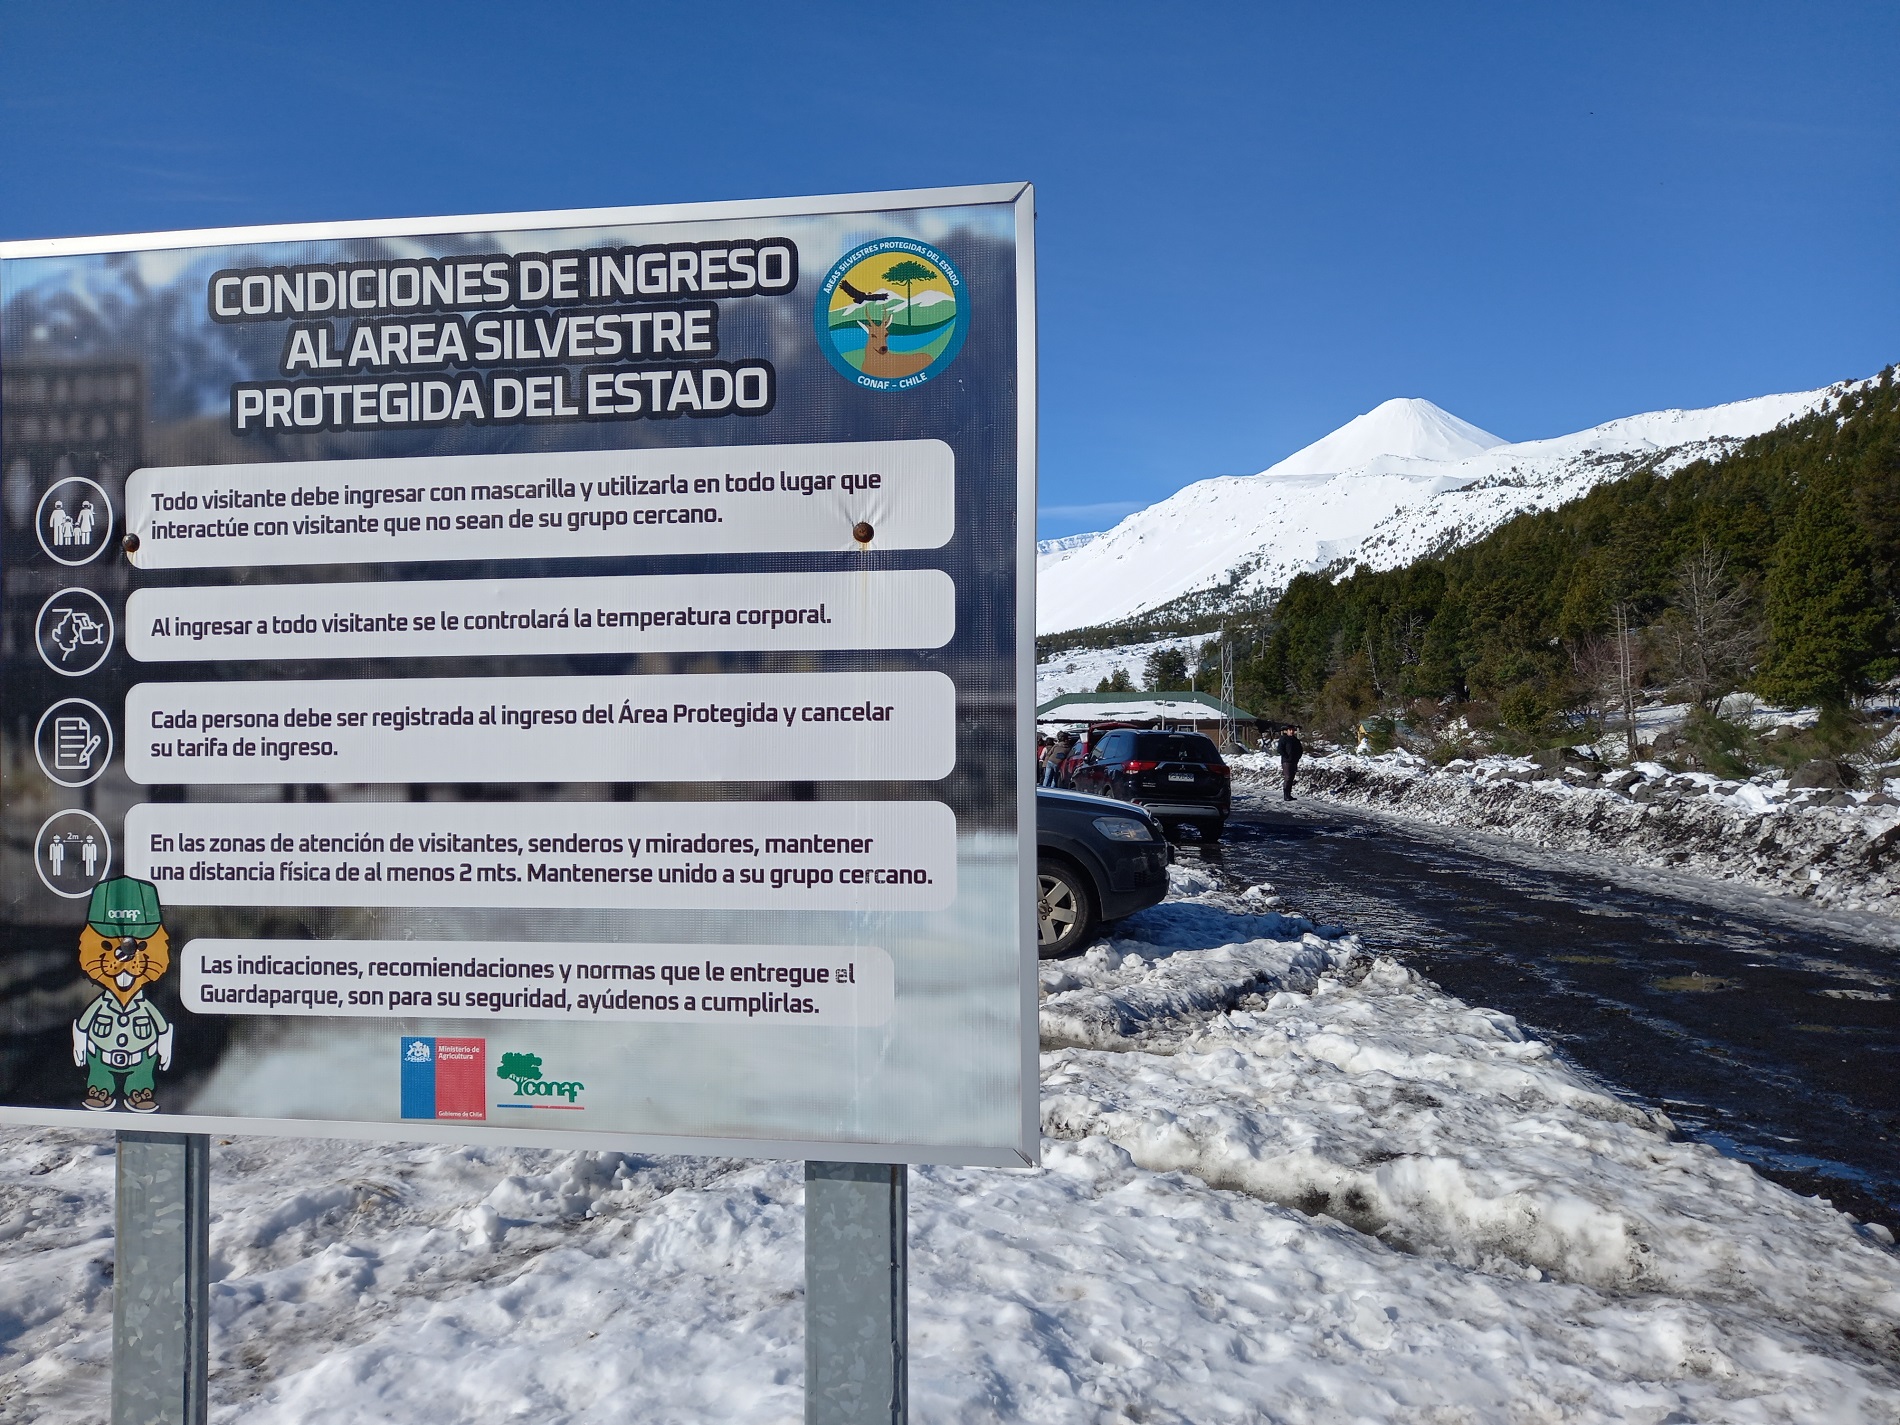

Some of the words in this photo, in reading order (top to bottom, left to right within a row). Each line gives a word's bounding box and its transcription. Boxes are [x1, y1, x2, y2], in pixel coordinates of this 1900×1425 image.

[214, 263, 510, 317] CONDICIONES
[519, 260, 578, 302] DE
[588, 246, 791, 299] INGRESO
[839, 244, 878, 272] SILVESTRES
[880, 242, 926, 254] PROTEGIDAS
[926, 251, 940, 265] DEL
[939, 260, 960, 286] ESTADO
[286, 329, 342, 371] AL
[348, 321, 468, 366] AREA
[475, 310, 712, 361] SILVESTRE
[238, 376, 484, 429] PROTEGIDA
[494, 375, 578, 418] DEL
[587, 367, 767, 415] ESTADO
[857, 376, 889, 389] CONAF
[899, 373, 927, 387] CHILE
[150, 490, 198, 512] Todo
[201, 488, 287, 510] visitante
[290, 486, 340, 507] debe
[344, 484, 426, 509] ingresar
[429, 486, 466, 502] con
[471, 477, 576, 501] mascarilla
[579, 482, 594, 502] y
[597, 473, 689, 497] utilizarla
[693, 478, 720, 494] en
[725, 471, 775, 493] todo
[780, 470, 837, 496] lugar
[840, 473, 882, 495] que
[151, 516, 249, 540] interactúe
[253, 521, 289, 537] con
[292, 514, 379, 535] visitante
[383, 516, 421, 537] que
[425, 515, 451, 531] no
[455, 514, 504, 530] sean
[508, 508, 534, 529] de
[538, 512, 563, 528] su
[567, 510, 628, 532] grupo
[633, 507, 723, 525] cercano.
[150, 617, 171, 637] Al
[175, 616, 253, 641] ingresar
[256, 620, 268, 635] a
[272, 614, 317, 635] todo
[321, 612, 408, 633] visitante
[412, 616, 436, 631] se
[440, 610, 459, 631] le
[463, 607, 569, 630] controlará
[573, 607, 592, 628] la
[596, 606, 731, 632] temperatura
[736, 603, 832, 630] corporal.
[151, 709, 197, 729] Cada
[201, 713, 279, 734] persona
[283, 707, 332, 728] debe
[336, 712, 369, 727] ser
[372, 705, 474, 732] registrada
[478, 705, 497, 726] al
[501, 704, 577, 730] ingreso
[582, 703, 615, 724] del
[617, 698, 668, 724] Área
[673, 701, 778, 728] Protegida
[782, 706, 797, 728] y
[801, 700, 895, 722] cancelar
[150, 742, 173, 758] su
[177, 736, 228, 757] tarifa
[232, 736, 257, 757] de
[260, 736, 338, 761] ingreso.
[67, 832, 79, 840] 2m
[150, 833, 174, 853] En
[178, 832, 206, 853] las
[209, 837, 266, 853] zonas
[270, 832, 294, 853] de
[298, 831, 385, 853] atención
[389, 832, 414, 853] de
[417, 832, 524, 857] visitantes,
[528, 832, 624, 853] senderos
[627, 838, 642, 859] y
[645, 832, 760, 857] miradores,
[765, 833, 874, 854] mantener
[150, 866, 185, 881] una
[189, 860, 275, 881] distancia
[279, 860, 331, 882] física
[335, 861, 360, 882] de
[364, 861, 383, 882] al
[386, 866, 455, 882] menos
[459, 863, 472, 882] 2
[476, 863, 522, 882] mts.
[527, 863, 653, 883] Mantenerse
[658, 862, 718, 884] unido
[722, 868, 735, 884] a
[739, 868, 765, 884] su
[769, 868, 834, 889] grupo
[839, 868, 933, 885] cercano.
[201, 955, 233, 975] Las
[237, 954, 364, 980] indicaciones,
[368, 956, 555, 979] recomiendaciones
[558, 963, 573, 984] y
[576, 964, 656, 981] normas
[660, 965, 700, 986] que
[705, 960, 725, 982] le
[730, 962, 830, 988] entregue
[835, 962, 856, 984] el
[200, 983, 344, 1010] Guardaparque,
[347, 990, 384, 1006] son
[388, 990, 433, 1011] para
[436, 991, 461, 1007] su
[465, 987, 573, 1013] seguridad,
[576, 987, 679, 1015] ayúdenos
[683, 995, 696, 1011] a
[701, 991, 820, 1018] cumplirlas.
